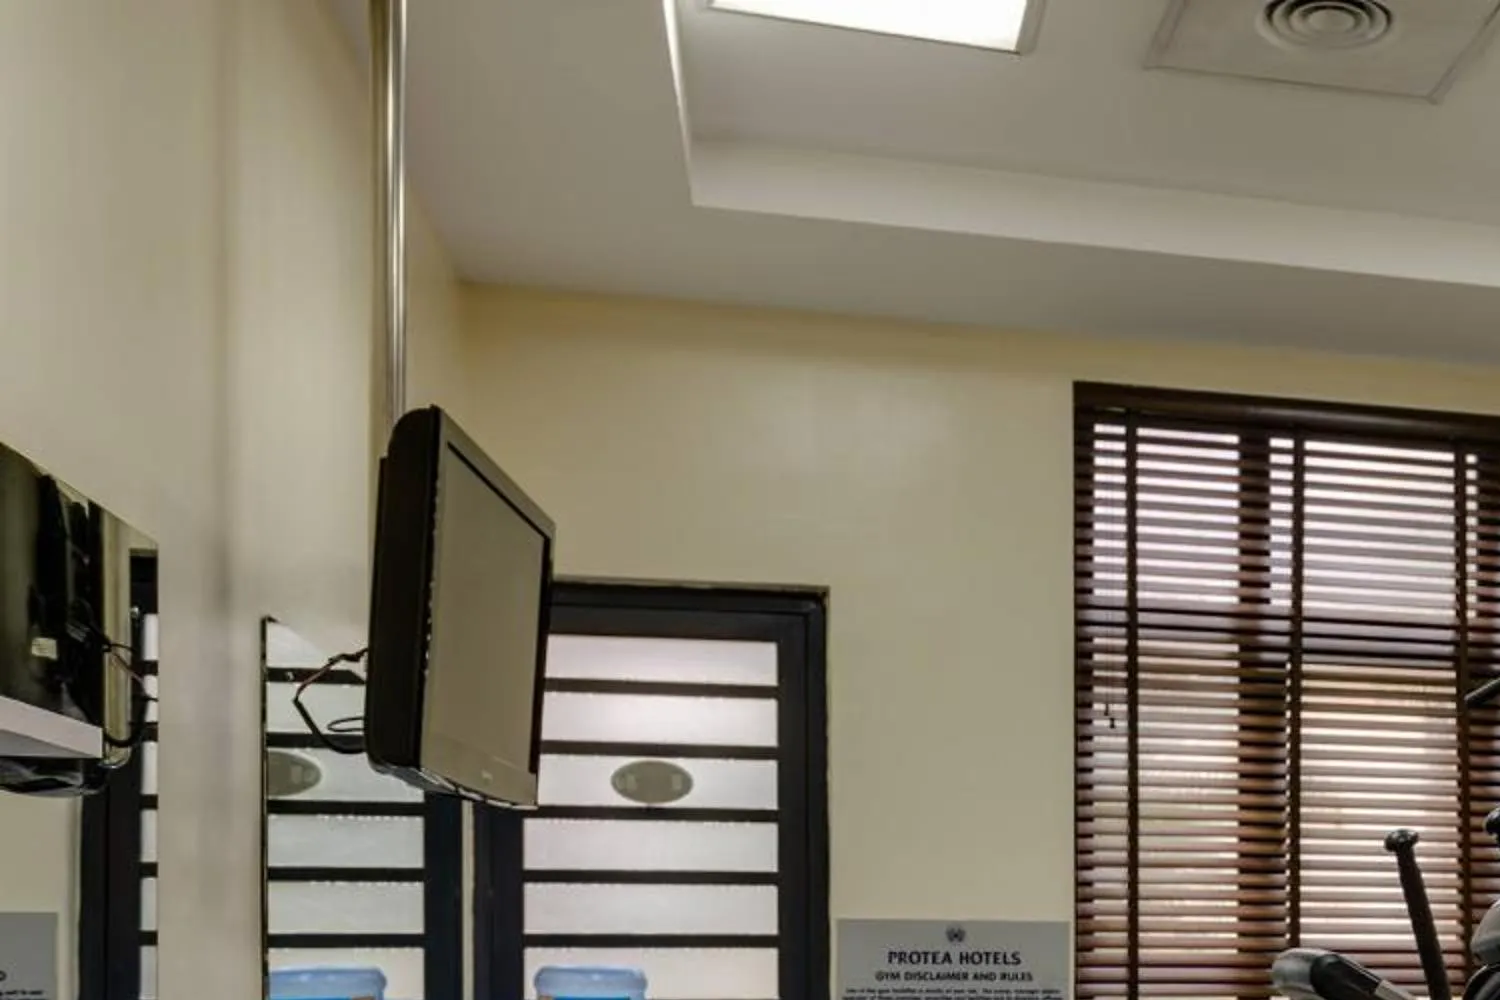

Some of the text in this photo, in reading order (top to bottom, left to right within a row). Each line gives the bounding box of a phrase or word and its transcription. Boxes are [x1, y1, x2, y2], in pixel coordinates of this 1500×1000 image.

[888, 951, 1022, 966] PROTEA HOTELS
[875, 971, 1034, 982] GYM DISCLAIMER AND RULES
